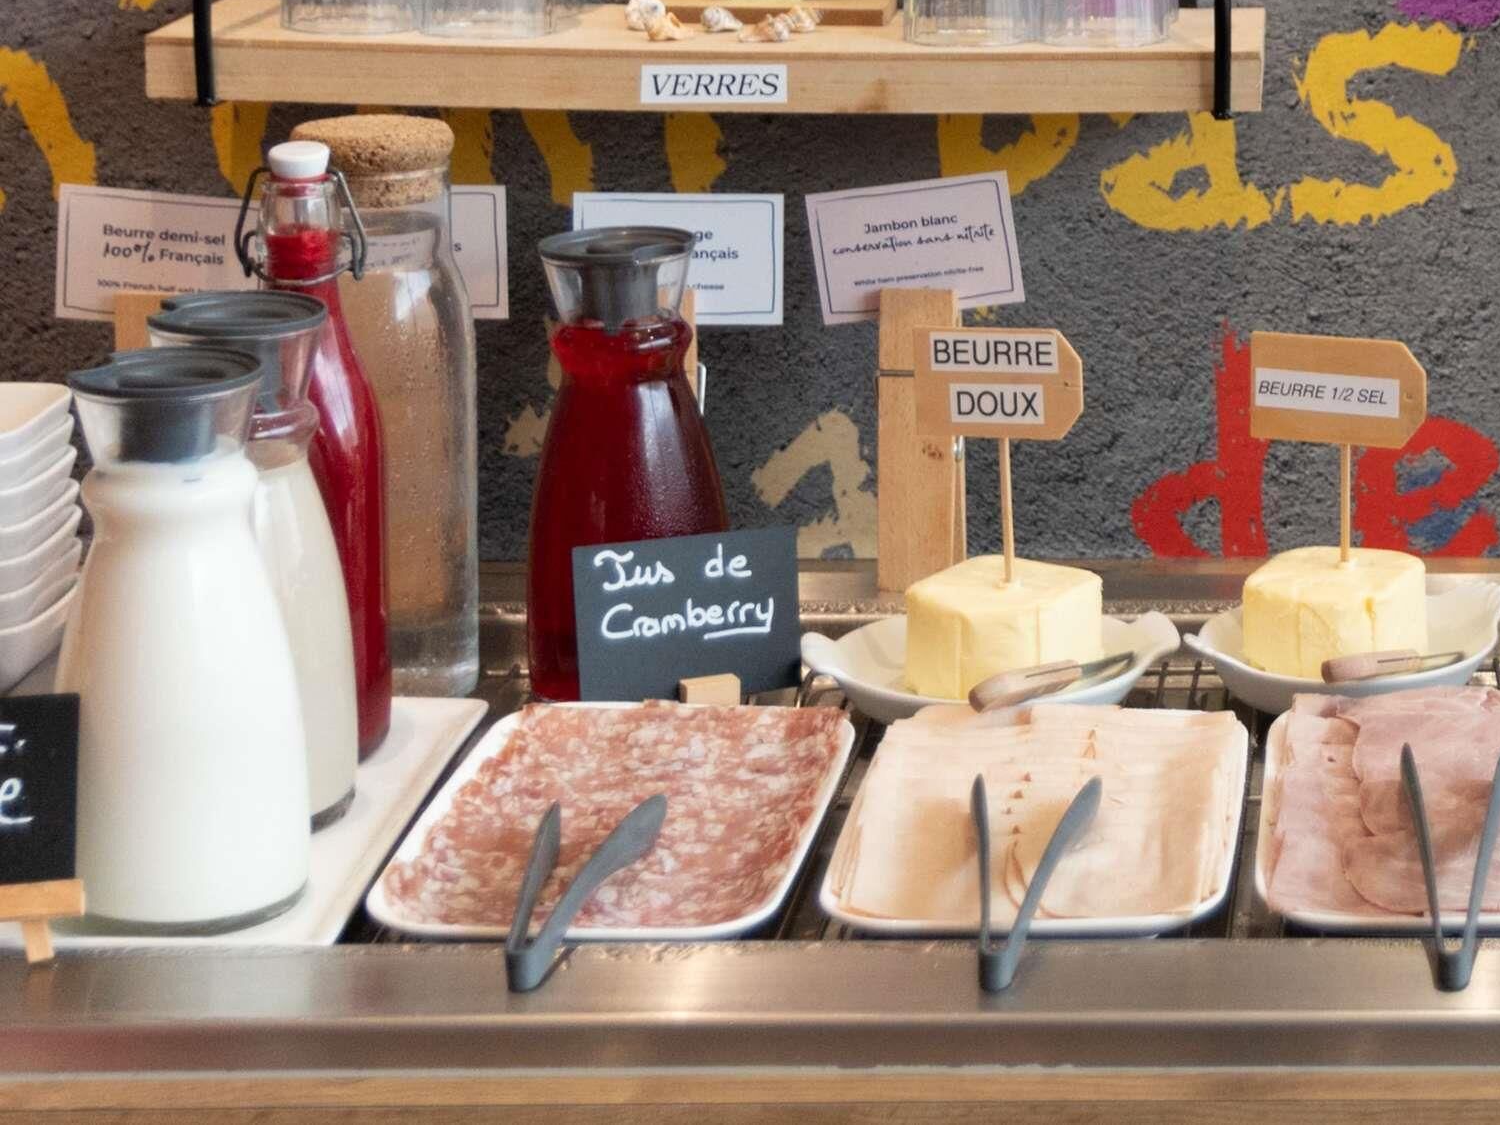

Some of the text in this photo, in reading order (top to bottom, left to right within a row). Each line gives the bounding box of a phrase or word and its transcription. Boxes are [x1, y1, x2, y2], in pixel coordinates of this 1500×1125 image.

[651, 73, 780, 97] VERRES
[103, 222, 227, 247] Beurre demi-sel
[863, 213, 958, 235] Jambon blanc
[831, 221, 996, 256] conservation sans nitrite
[102, 240, 225, 268] 100% Français
[691, 245, 740, 263] ançais
[933, 338, 1053, 367] BEURRE
[956, 390, 1039, 418] DOUX
[1258, 380, 1388, 406] BEURRE 1/2 SEL
[593, 542, 753, 592] Jus de
